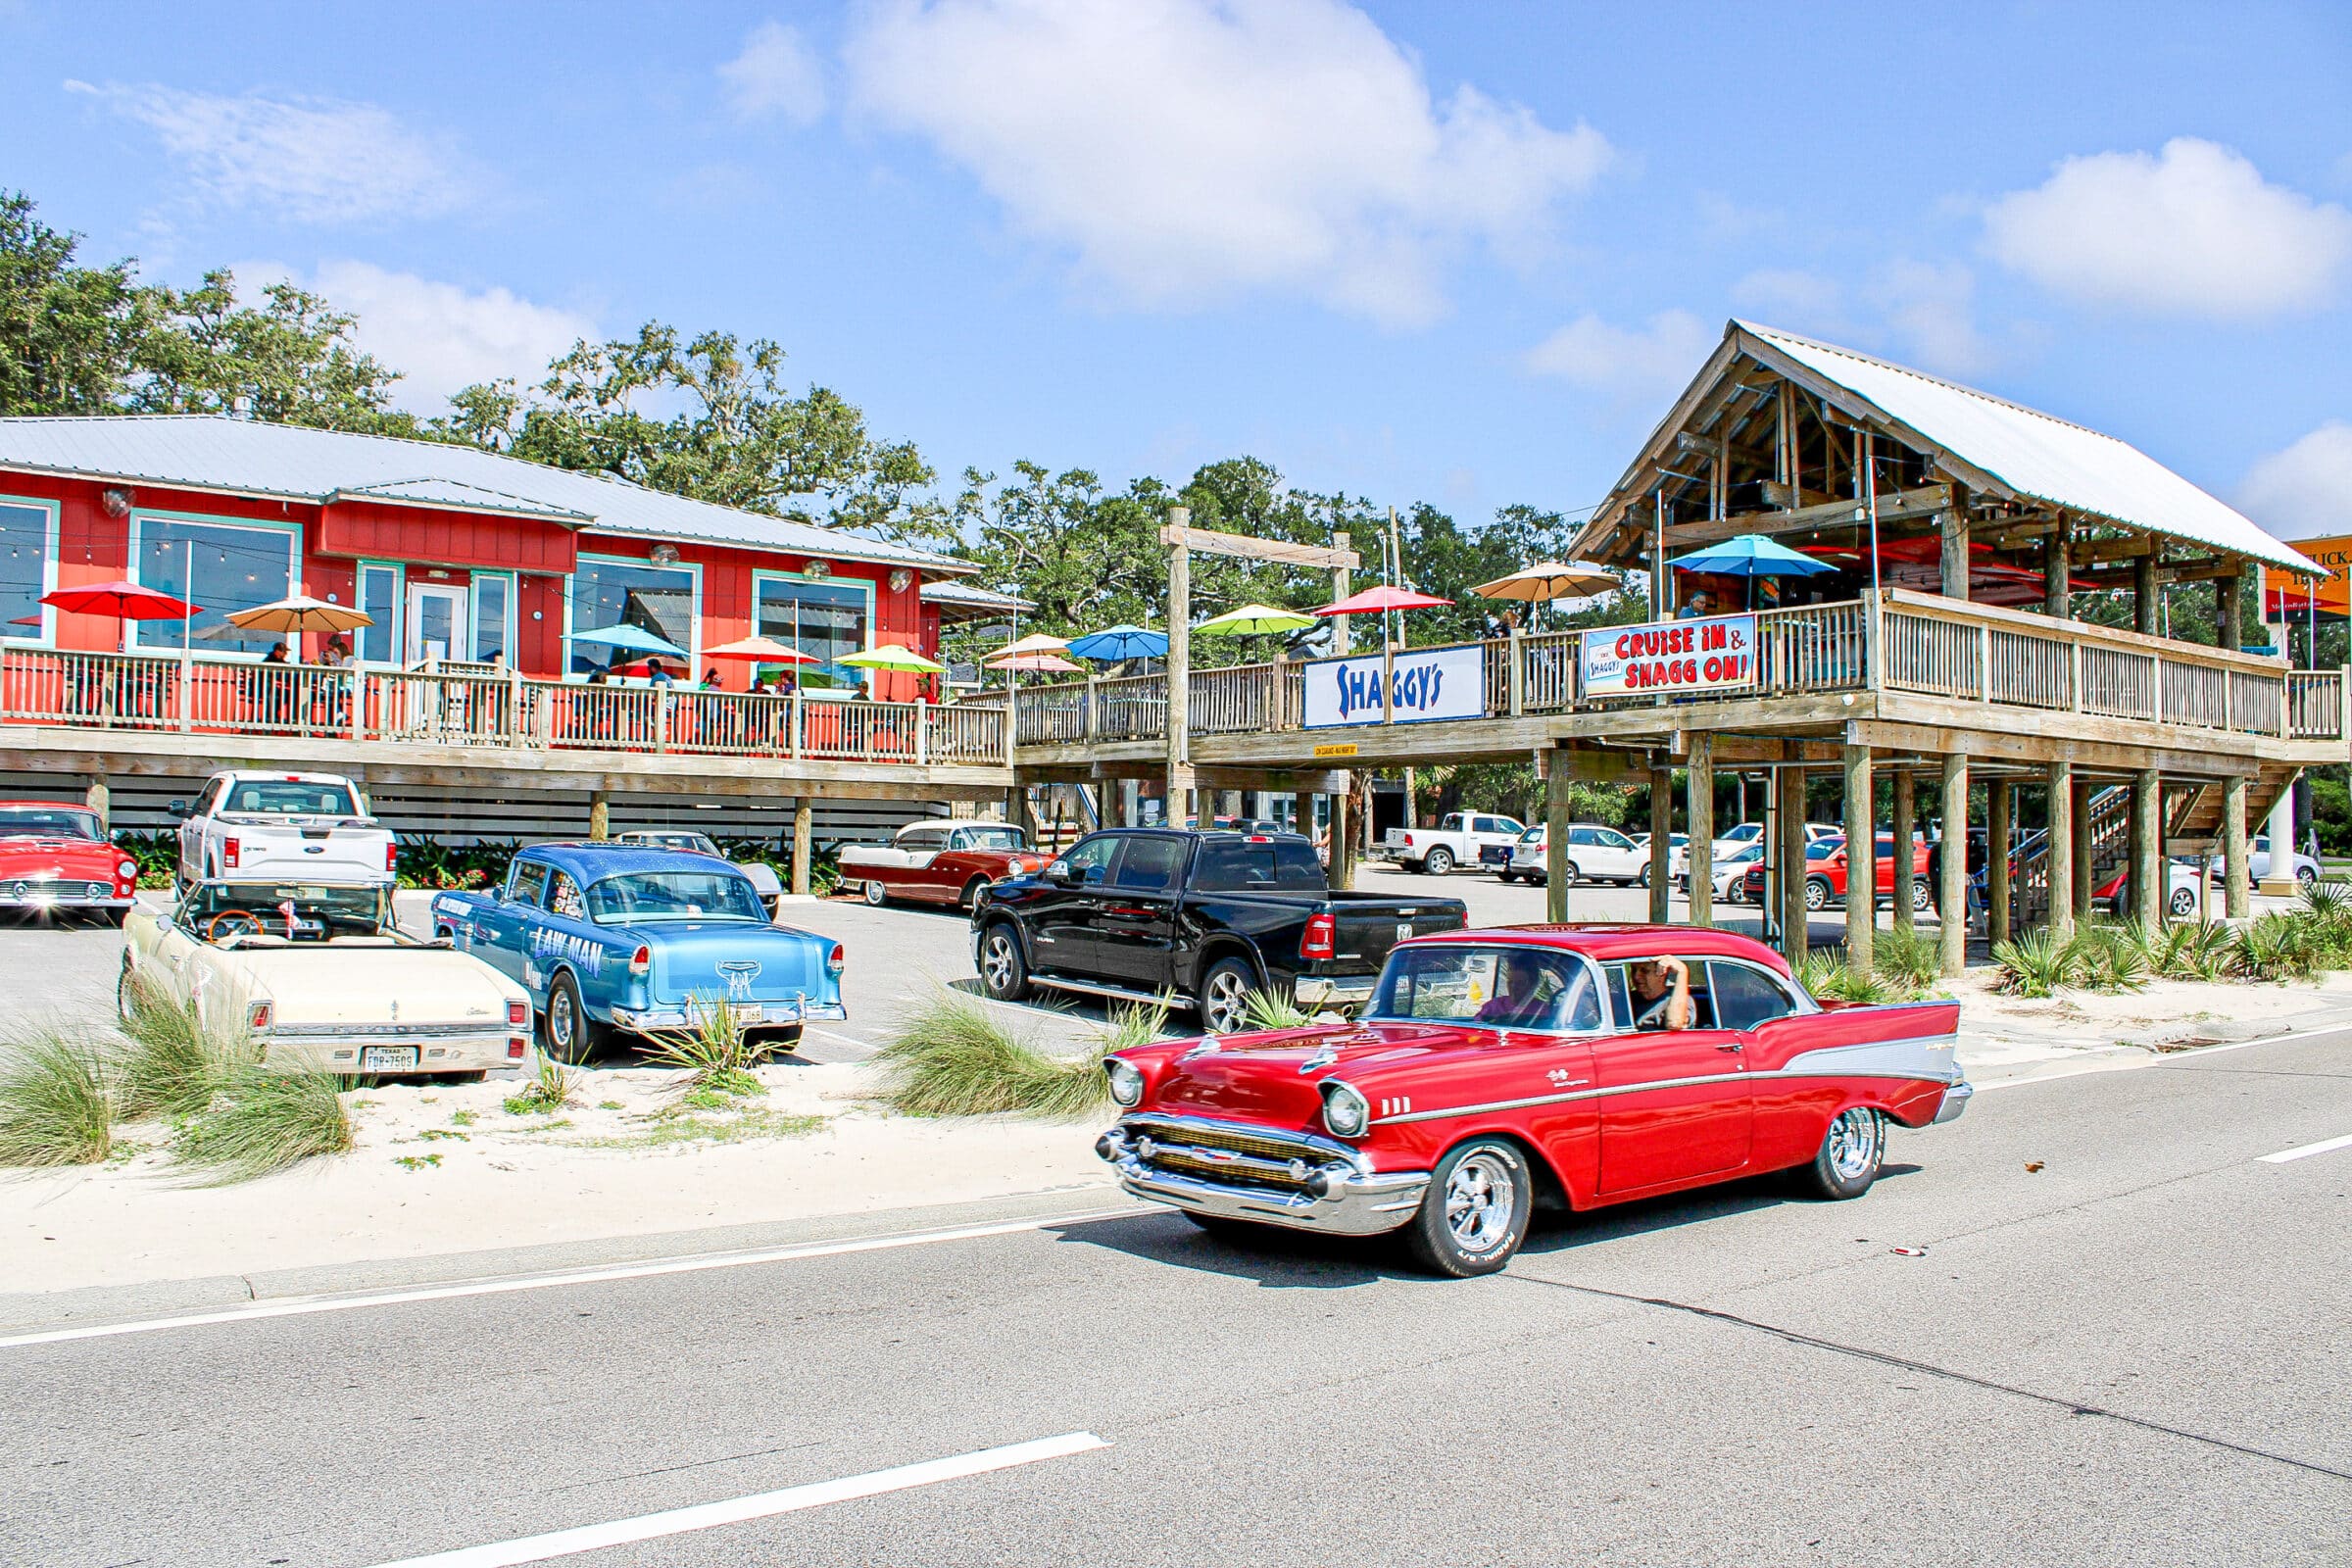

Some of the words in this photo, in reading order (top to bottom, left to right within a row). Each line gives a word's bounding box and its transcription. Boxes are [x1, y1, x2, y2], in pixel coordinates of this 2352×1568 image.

[1730, 629, 1747, 651] &
[1625, 659, 1697, 688] SHAGG
[1703, 654, 1748, 682] ON!
[1337, 662, 1444, 721] SHAGGY'S
[534, 926, 568, 959] LAW
[567, 936, 604, 979] MAN
[1481, 1231, 1515, 1261] RADIAL
